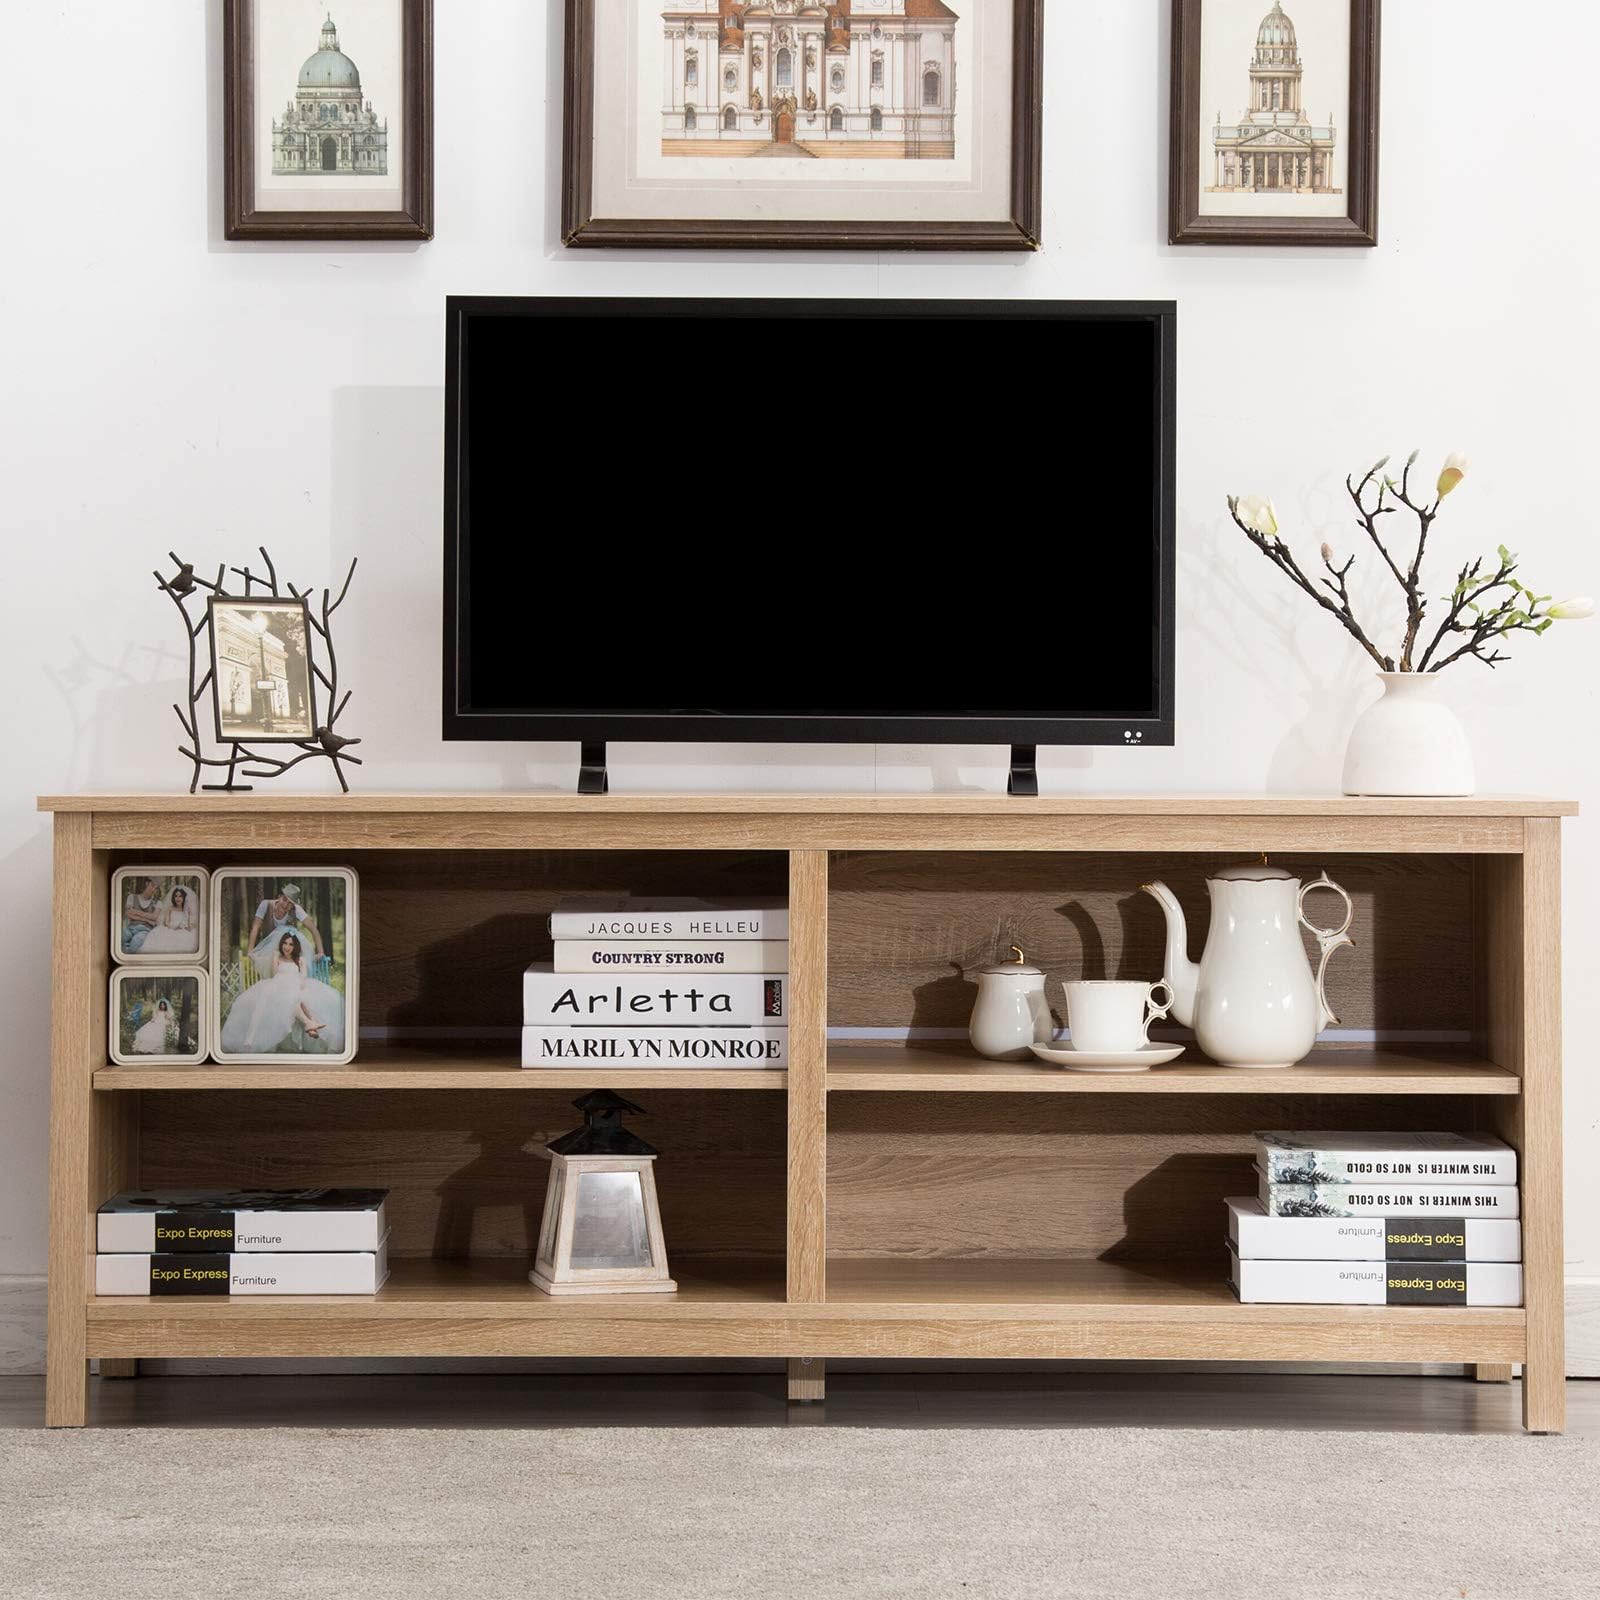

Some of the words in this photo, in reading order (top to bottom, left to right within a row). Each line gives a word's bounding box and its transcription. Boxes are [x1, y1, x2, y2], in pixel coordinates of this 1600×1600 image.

[588, 922, 673, 934] JACQUES
[690, 921, 760, 933] HELLEU
[666, 951, 725, 964] STRONG
[551, 986, 732, 1013] Arletta
[541, 1038, 662, 1058] MARILYN
[668, 1039, 781, 1058] MONROE
[1346, 1162, 1373, 1173] COLD
[1375, 1163, 1389, 1174] SO
[1391, 1163, 1412, 1174] NOT
[1417, 1163, 1429, 1174] IS
[1431, 1163, 1472, 1174] WINTER
[1474, 1163, 1497, 1174] THIS
[1348, 1194, 1374, 1205] COLD
[1377, 1194, 1391, 1205] SO
[1393, 1194, 1413, 1206] NOT
[1419, 1195, 1430, 1206] IS
[1432, 1195, 1472, 1206] WINTER
[1475, 1195, 1498, 1206] THIS
[157, 1228, 186, 1240] Expo
[188, 1228, 233, 1240] Express
[1338, 1228, 1383, 1238] Furniture
[237, 1235, 282, 1245] Furniture
[1387, 1234, 1432, 1245] Express
[1435, 1235, 1464, 1246] Expo
[152, 1269, 181, 1281] Expo
[183, 1269, 228, 1281] Express
[1339, 1271, 1384, 1281] Furniture
[232, 1276, 277, 1287] Furniture
[1388, 1279, 1433, 1290] Express
[1436, 1280, 1465, 1291] Expo
